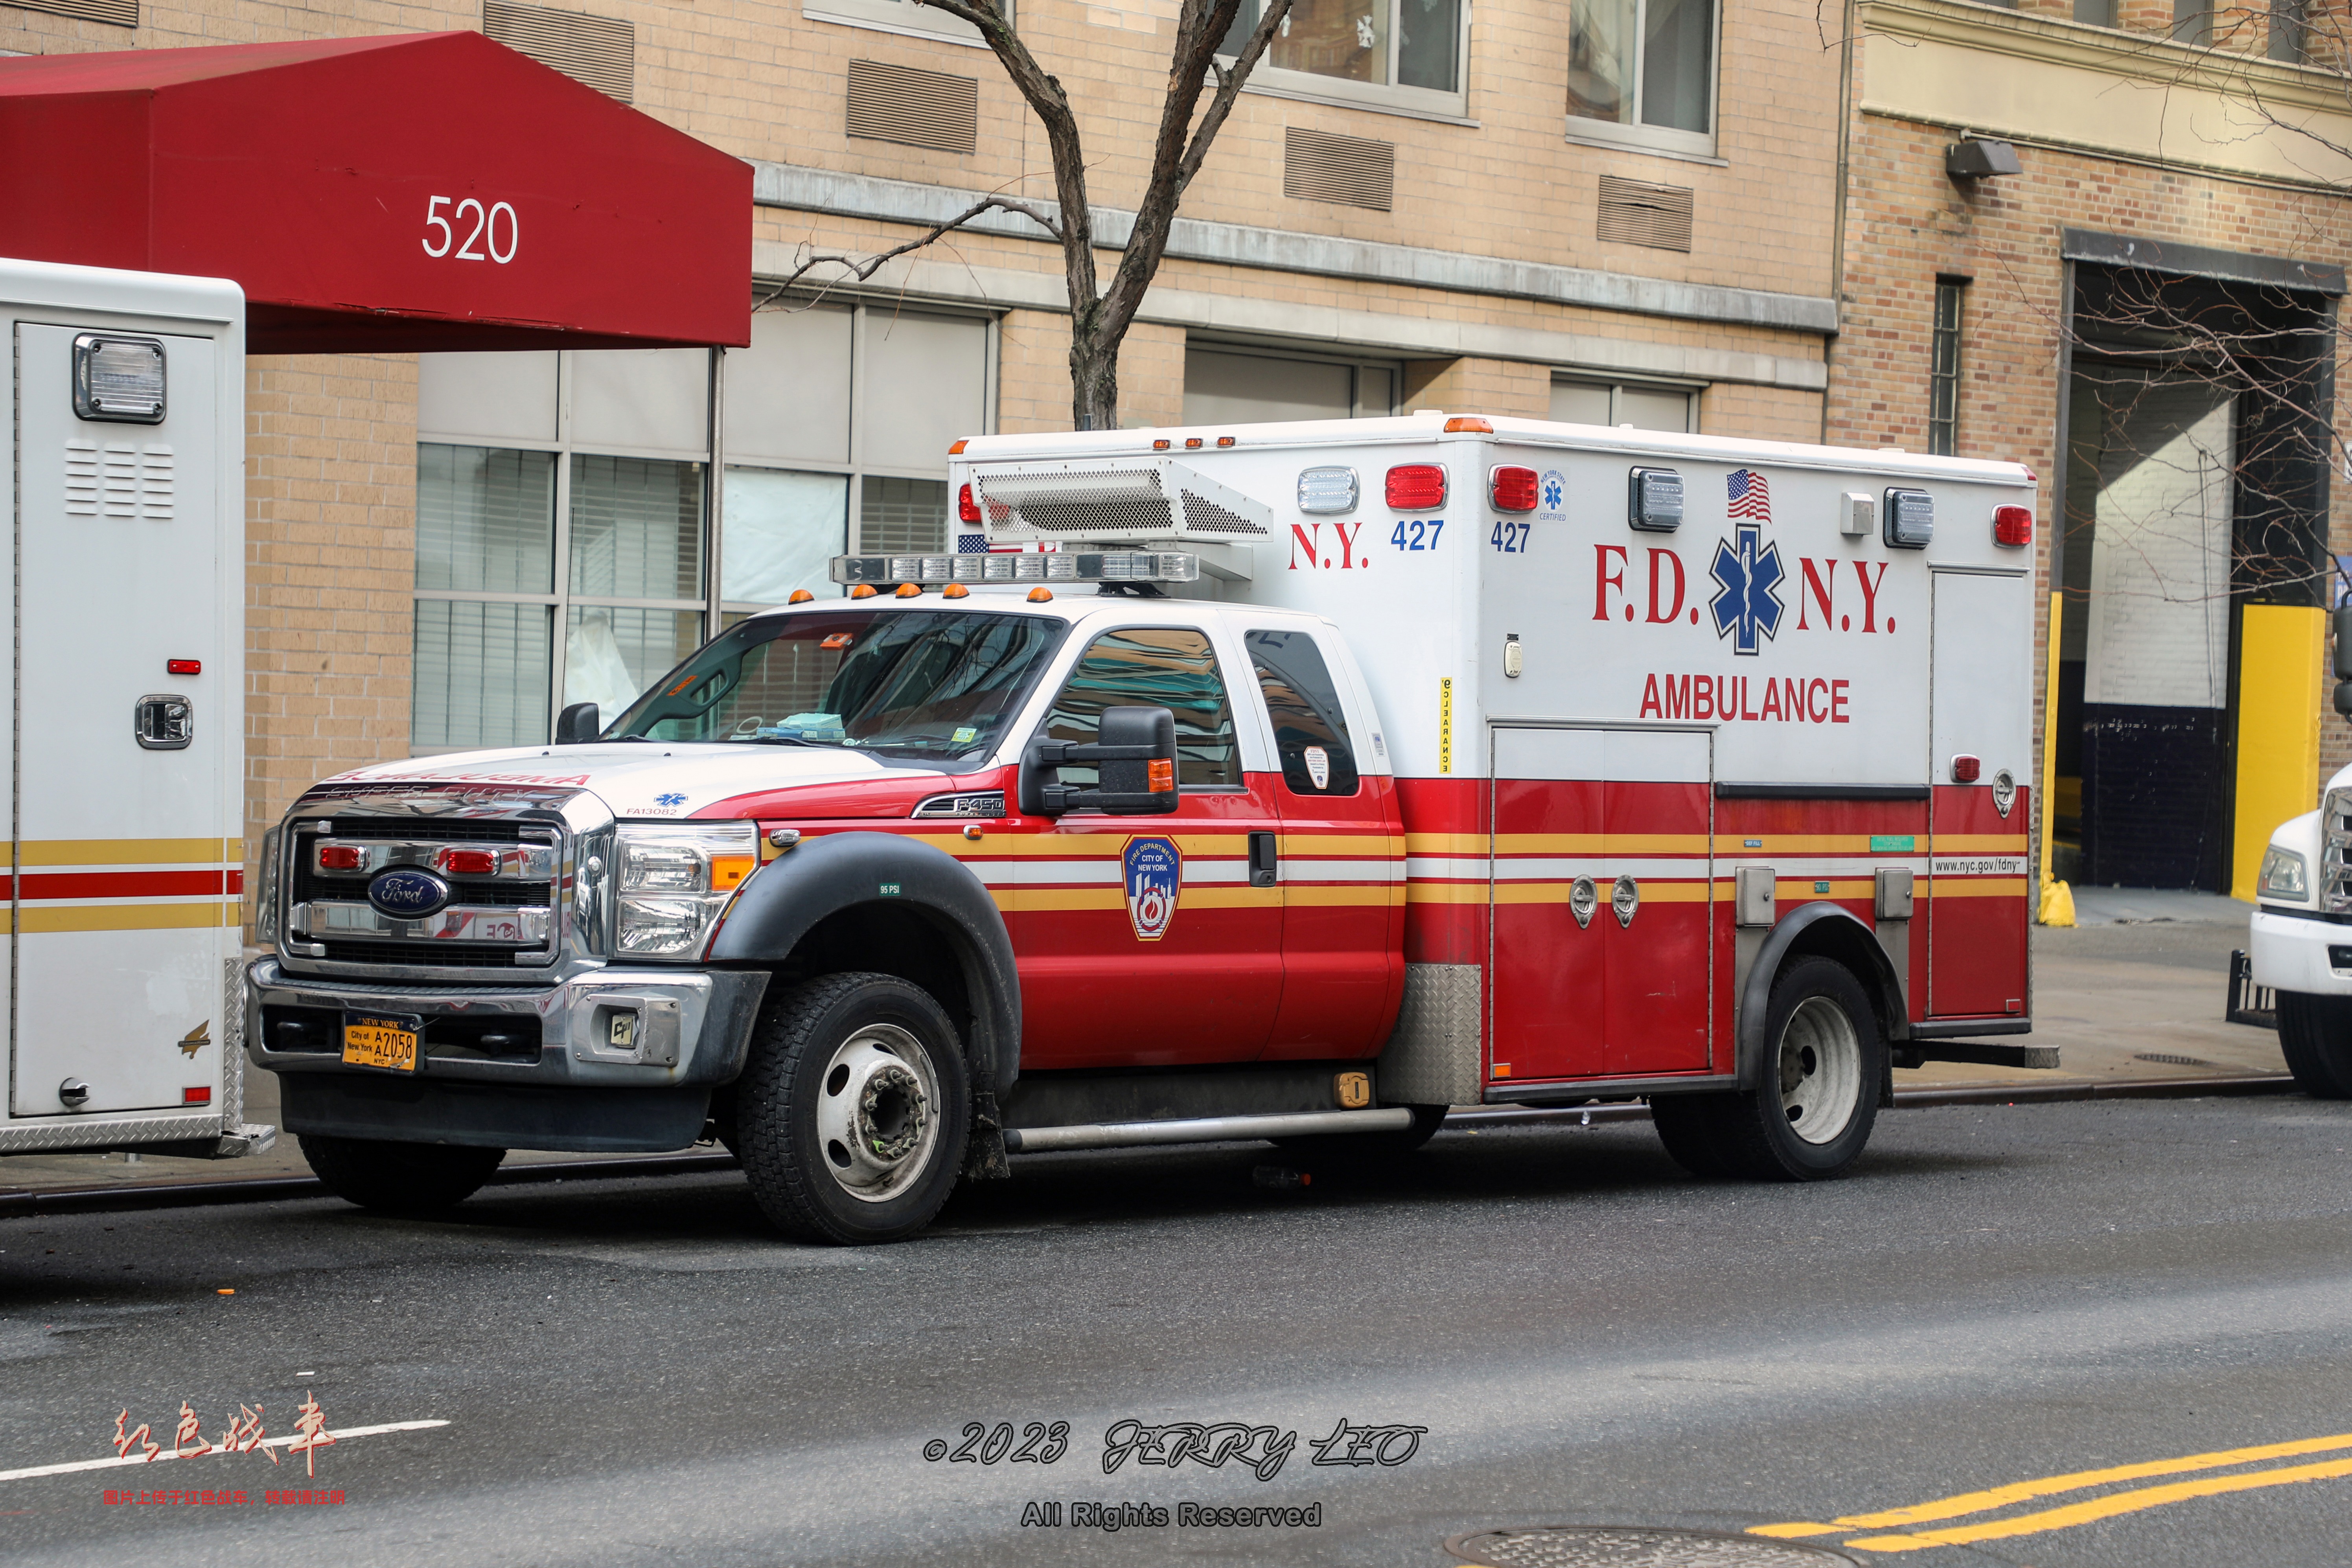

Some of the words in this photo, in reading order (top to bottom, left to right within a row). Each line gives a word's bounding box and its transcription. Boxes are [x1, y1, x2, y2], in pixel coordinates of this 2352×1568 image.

[422, 195, 518, 264] 520
[1557, 472, 1566, 485] STATE
[1540, 513, 1566, 521] CERTIFIED
[1288, 522, 1368, 570] N.Y.
[1391, 519, 1444, 551] 427
[1491, 521, 1530, 553] 427
[1592, 544, 1699, 626] F.D.
[1797, 557, 1896, 634] N.Y.
[1640, 674, 1849, 723] AMBULANCE
[326, 786, 429, 799] SUPER
[437, 787, 539, 801] DUTY
[1130, 849, 1141, 866] FIRE
[1140, 843, 1175, 865] DEPARTMENT
[1936, 857, 2017, 874] www.nyc.gov/fdny
[382, 878, 423, 903] Ford
[880, 885, 888, 894] 95
[889, 885, 899, 894] PSI
[351, 1031, 362, 1040] City
[380, 1020, 399, 1029] YORK
[383, 1032, 412, 1059] 2058
